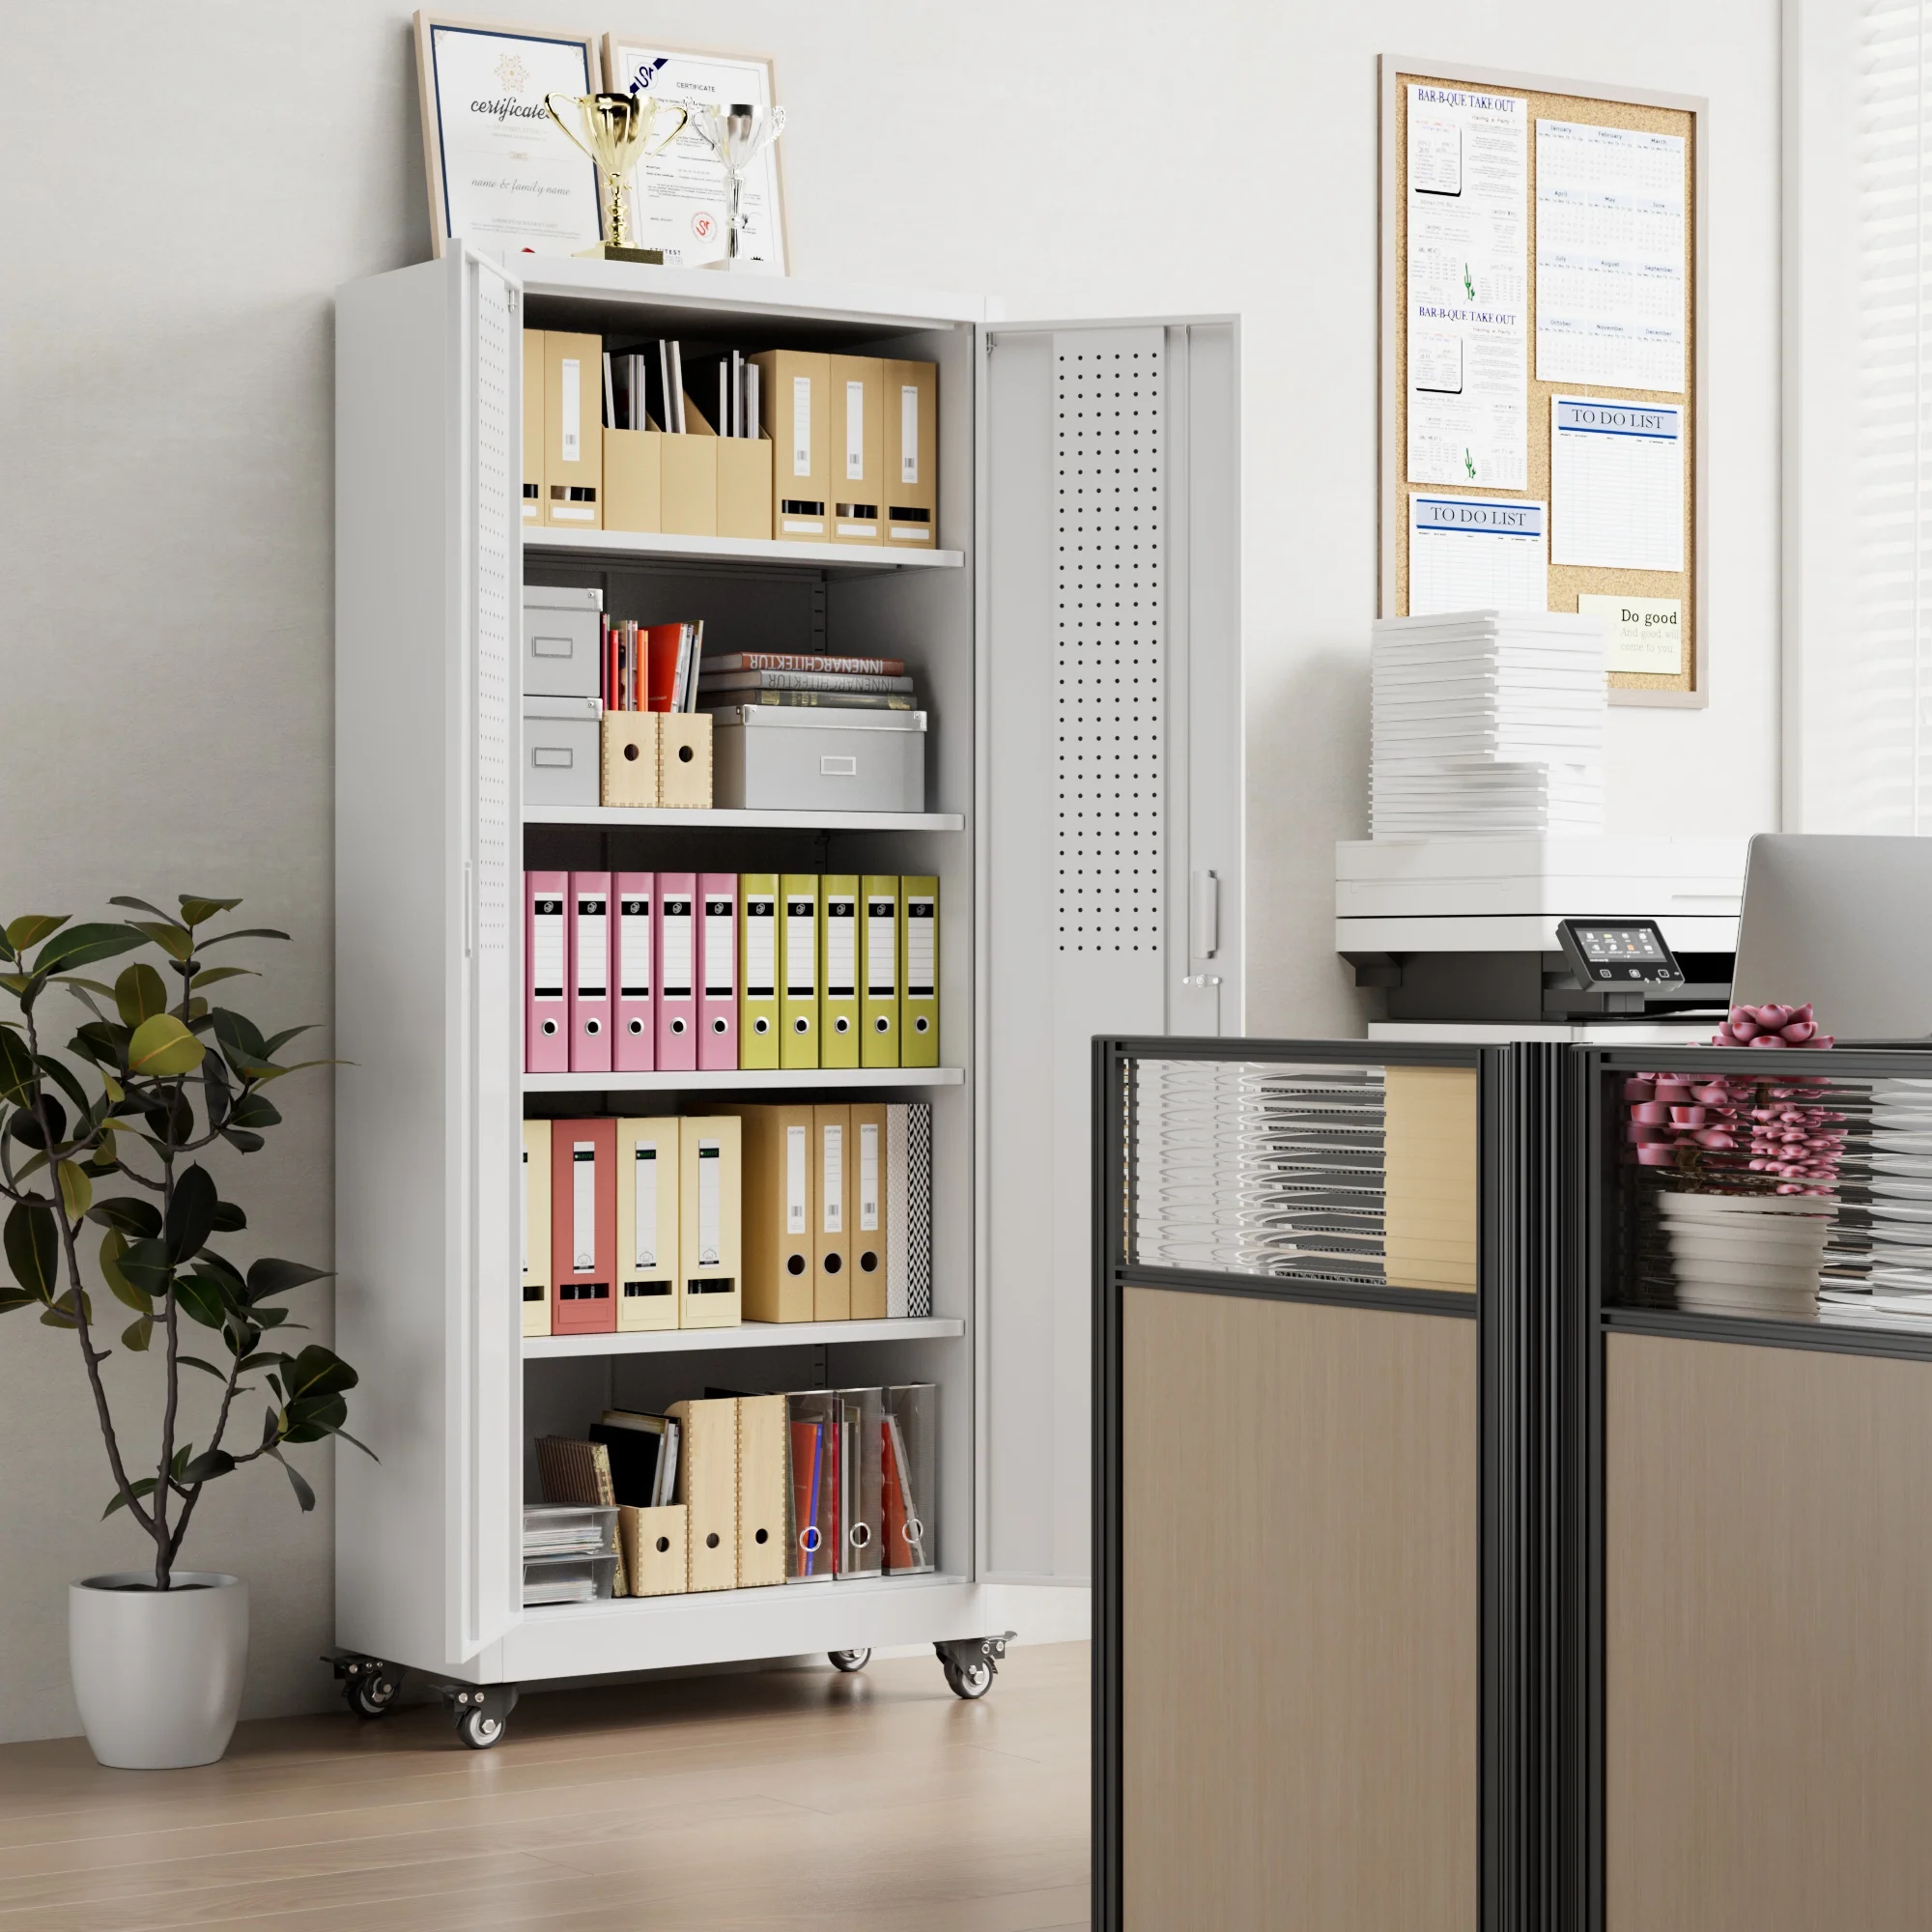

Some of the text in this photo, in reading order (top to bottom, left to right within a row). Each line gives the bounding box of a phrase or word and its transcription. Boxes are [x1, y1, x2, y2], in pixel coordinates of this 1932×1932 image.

[676, 82, 716, 93] CERTIFICATE
[1418, 88, 1516, 112] BAR-B-QUE TAKE OUT
[1550, 125, 1572, 133] January
[1598, 130, 1623, 140] February
[471, 178, 572, 197] name & family name
[1644, 265, 1673, 273] September
[1418, 306, 1516, 326] BAR-B-QUE TAKE OUT
[1572, 409, 1663, 429] TO DO LIST
[1431, 506, 1527, 526] TO DO LIST
[1621, 609, 1677, 626] Do good
[1621, 627, 1638, 638] And
[1641, 629, 1662, 639] good
[1620, 642, 1644, 652] come
[1646, 643, 1655, 652] to
[750, 654, 883, 675] INNENARCHITEKTUR
[768, 673, 894, 693] INNENARCHITEKTUR
